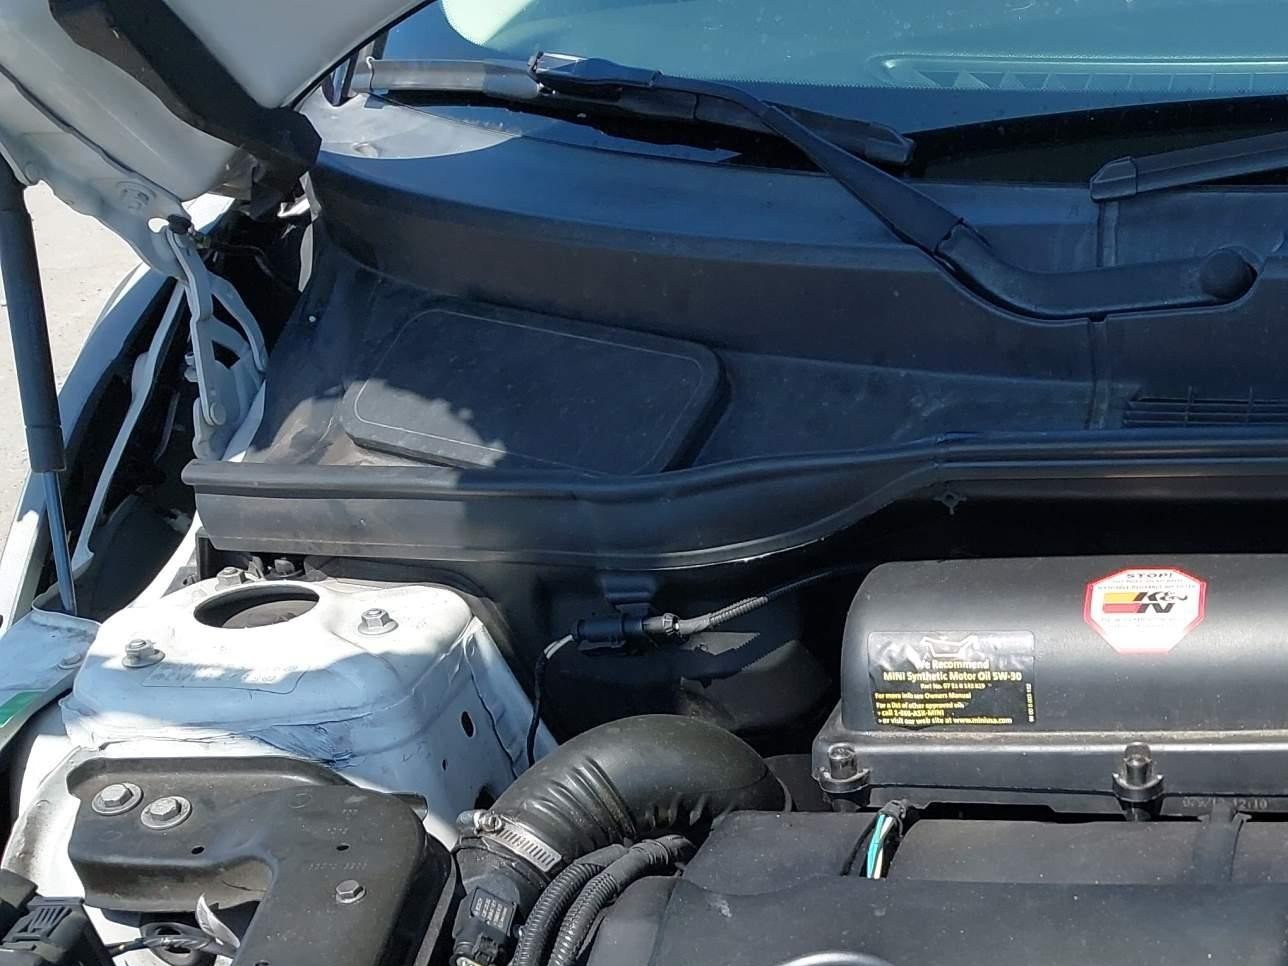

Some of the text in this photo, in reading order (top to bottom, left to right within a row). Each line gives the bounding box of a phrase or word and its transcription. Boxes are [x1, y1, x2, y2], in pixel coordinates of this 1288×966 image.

[932, 659, 990, 670] Recommend
[883, 671, 1023, 683] MINI Synthetic Motor Oil 5W-30
